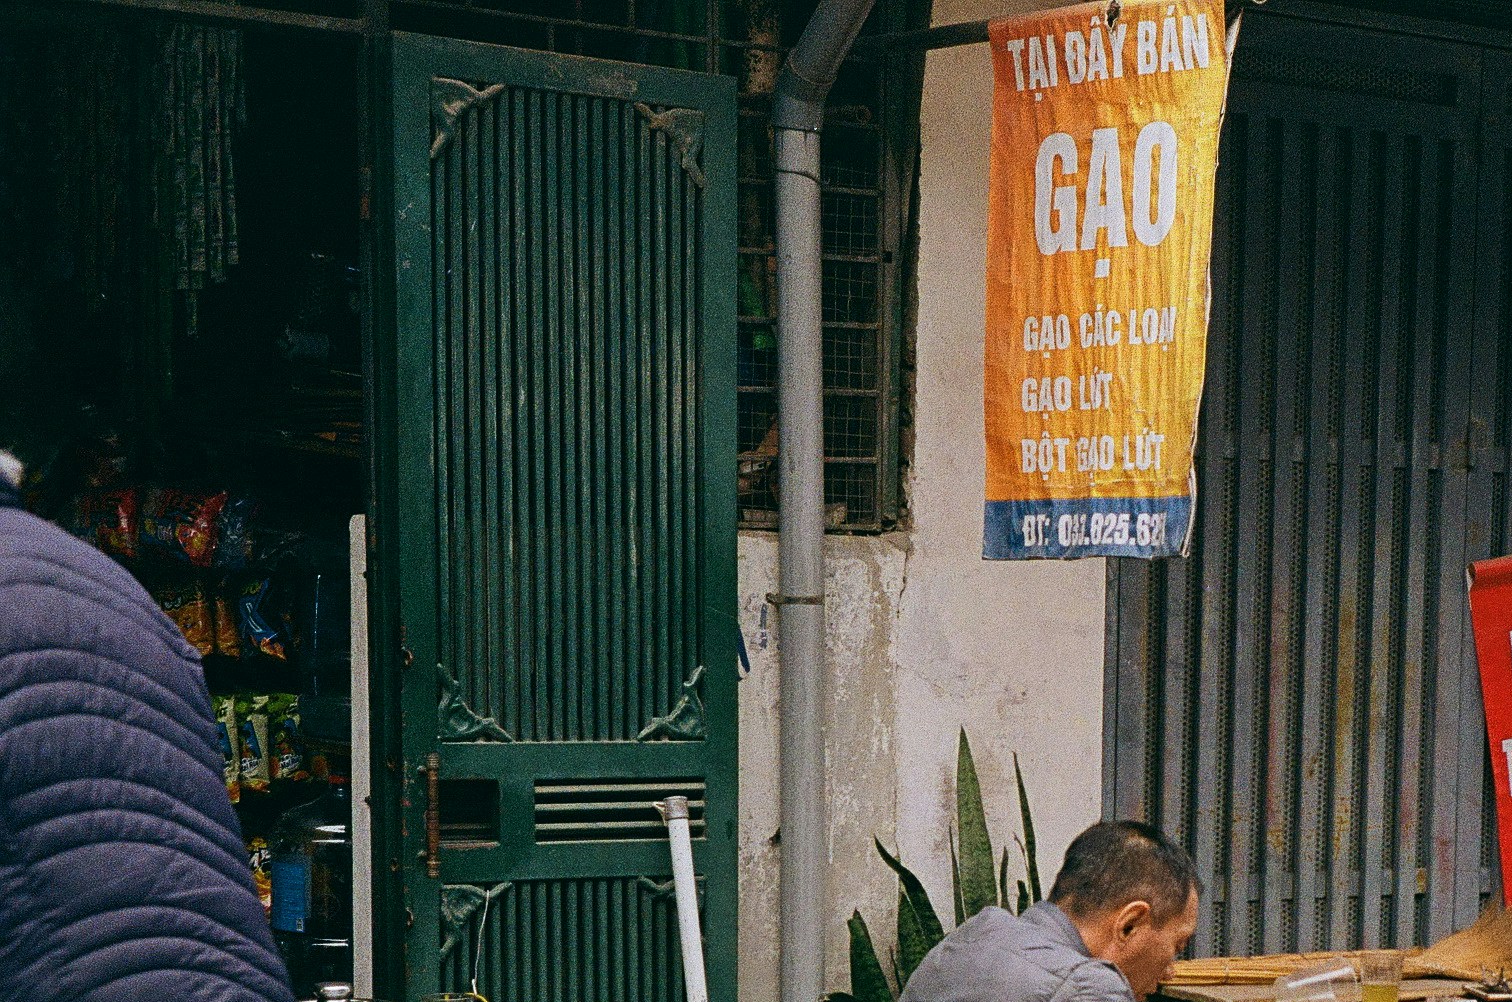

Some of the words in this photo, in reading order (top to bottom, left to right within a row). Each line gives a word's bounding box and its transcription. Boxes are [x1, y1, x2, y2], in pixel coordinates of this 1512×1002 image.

[1007, 35, 1058, 101] TẠI
[1064, 16, 1127, 85] ĐÂY
[1137, 5, 1209, 76] BÁN
[1034, 121, 1178, 279] GẠO
[1023, 313, 1071, 358] GẠO
[1079, 303, 1122, 349] CÁC
[1128, 306, 1178, 352] LOẠI
[1021, 375, 1072, 420] GẠO
[1021, 430, 1070, 481] BỘT
[1076, 434, 1115, 480] GẠO
[1122, 427, 1165, 471] LỨT
